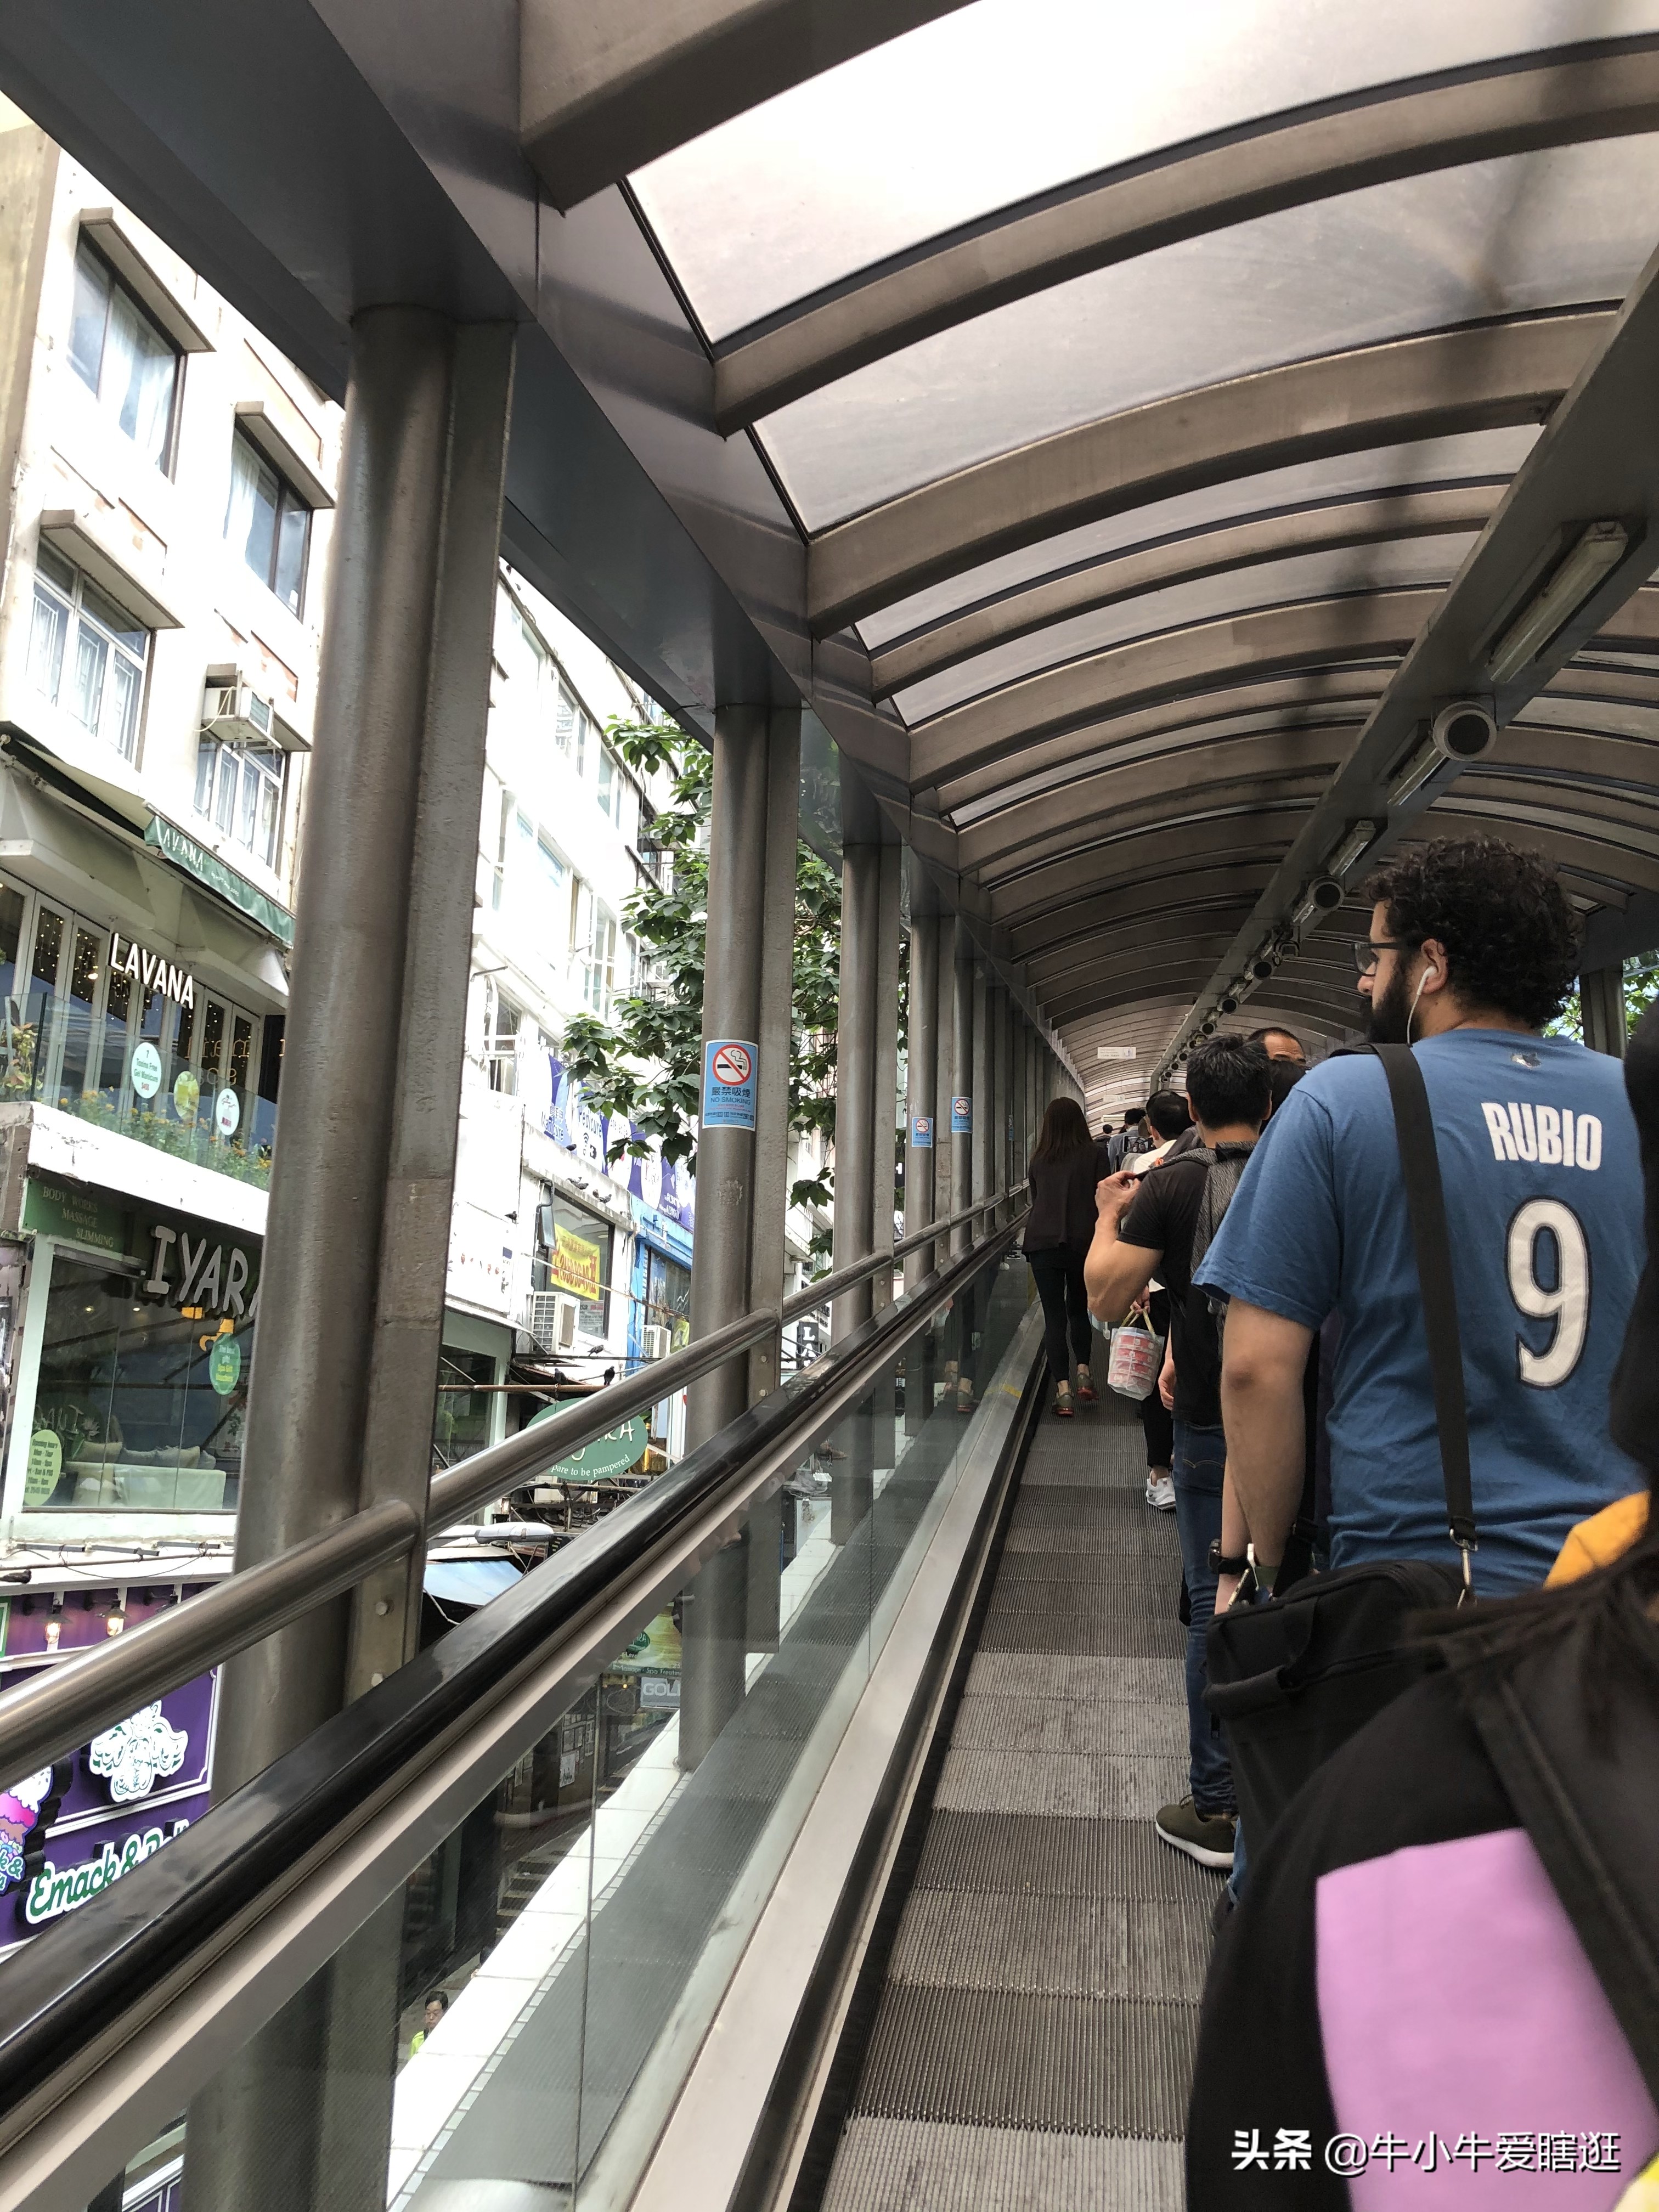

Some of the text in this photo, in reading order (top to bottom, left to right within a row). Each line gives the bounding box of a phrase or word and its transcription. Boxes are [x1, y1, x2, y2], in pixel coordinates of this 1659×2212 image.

[110, 932, 194, 1010] LAVANA
[146, 1049, 150, 1058] 7
[711, 1086, 751, 1098] 嚴禁吸煙
[721, 1097, 751, 1105] SMOKING
[540, 1111, 565, 1142] Manicure
[578, 1105, 603, 1138] Pedicure
[1481, 1102, 1602, 1171] RUBIO
[43, 1186, 98, 1213] BODY WORKS
[61, 1207, 97, 1228] MASSAGE
[75, 1227, 114, 1248] SLIMMING
[1506, 1196, 1590, 1390] 9
[550, 1454, 631, 1478] pare to be pampered
[659, 1668, 681, 1676] Treatm
[29, 1844, 117, 1918] Emack
